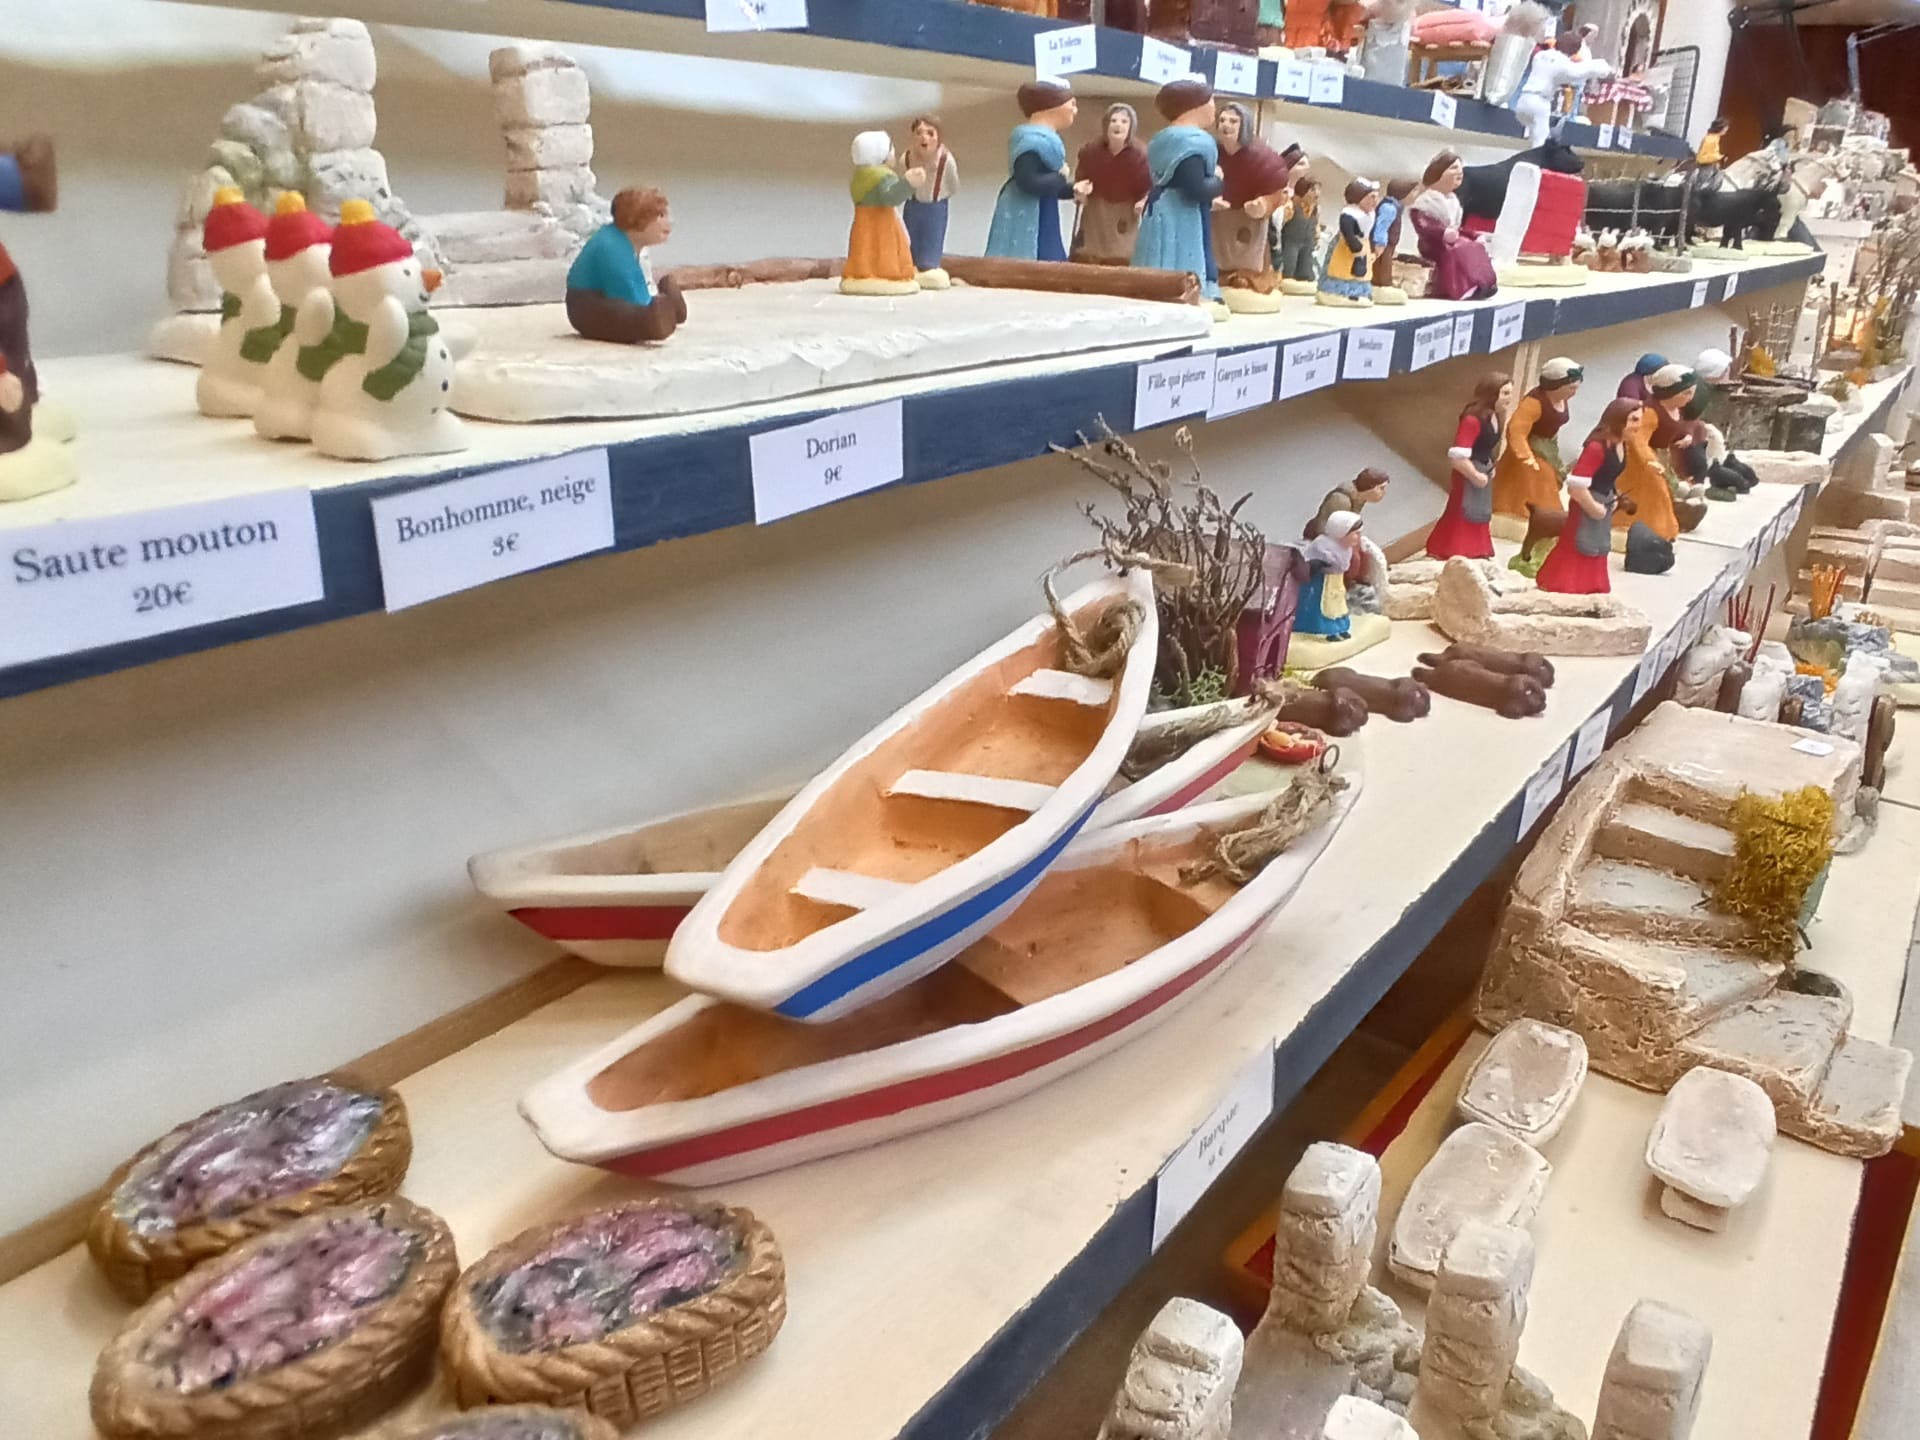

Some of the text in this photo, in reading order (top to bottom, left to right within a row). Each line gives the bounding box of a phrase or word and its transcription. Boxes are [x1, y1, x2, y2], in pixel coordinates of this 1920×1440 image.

[806, 430, 858, 459] Dorian
[540, 475, 597, 506] neige
[824, 464, 843, 486] 9€
[12, 518, 279, 584] Saute mouton
[133, 580, 193, 613] 20€
